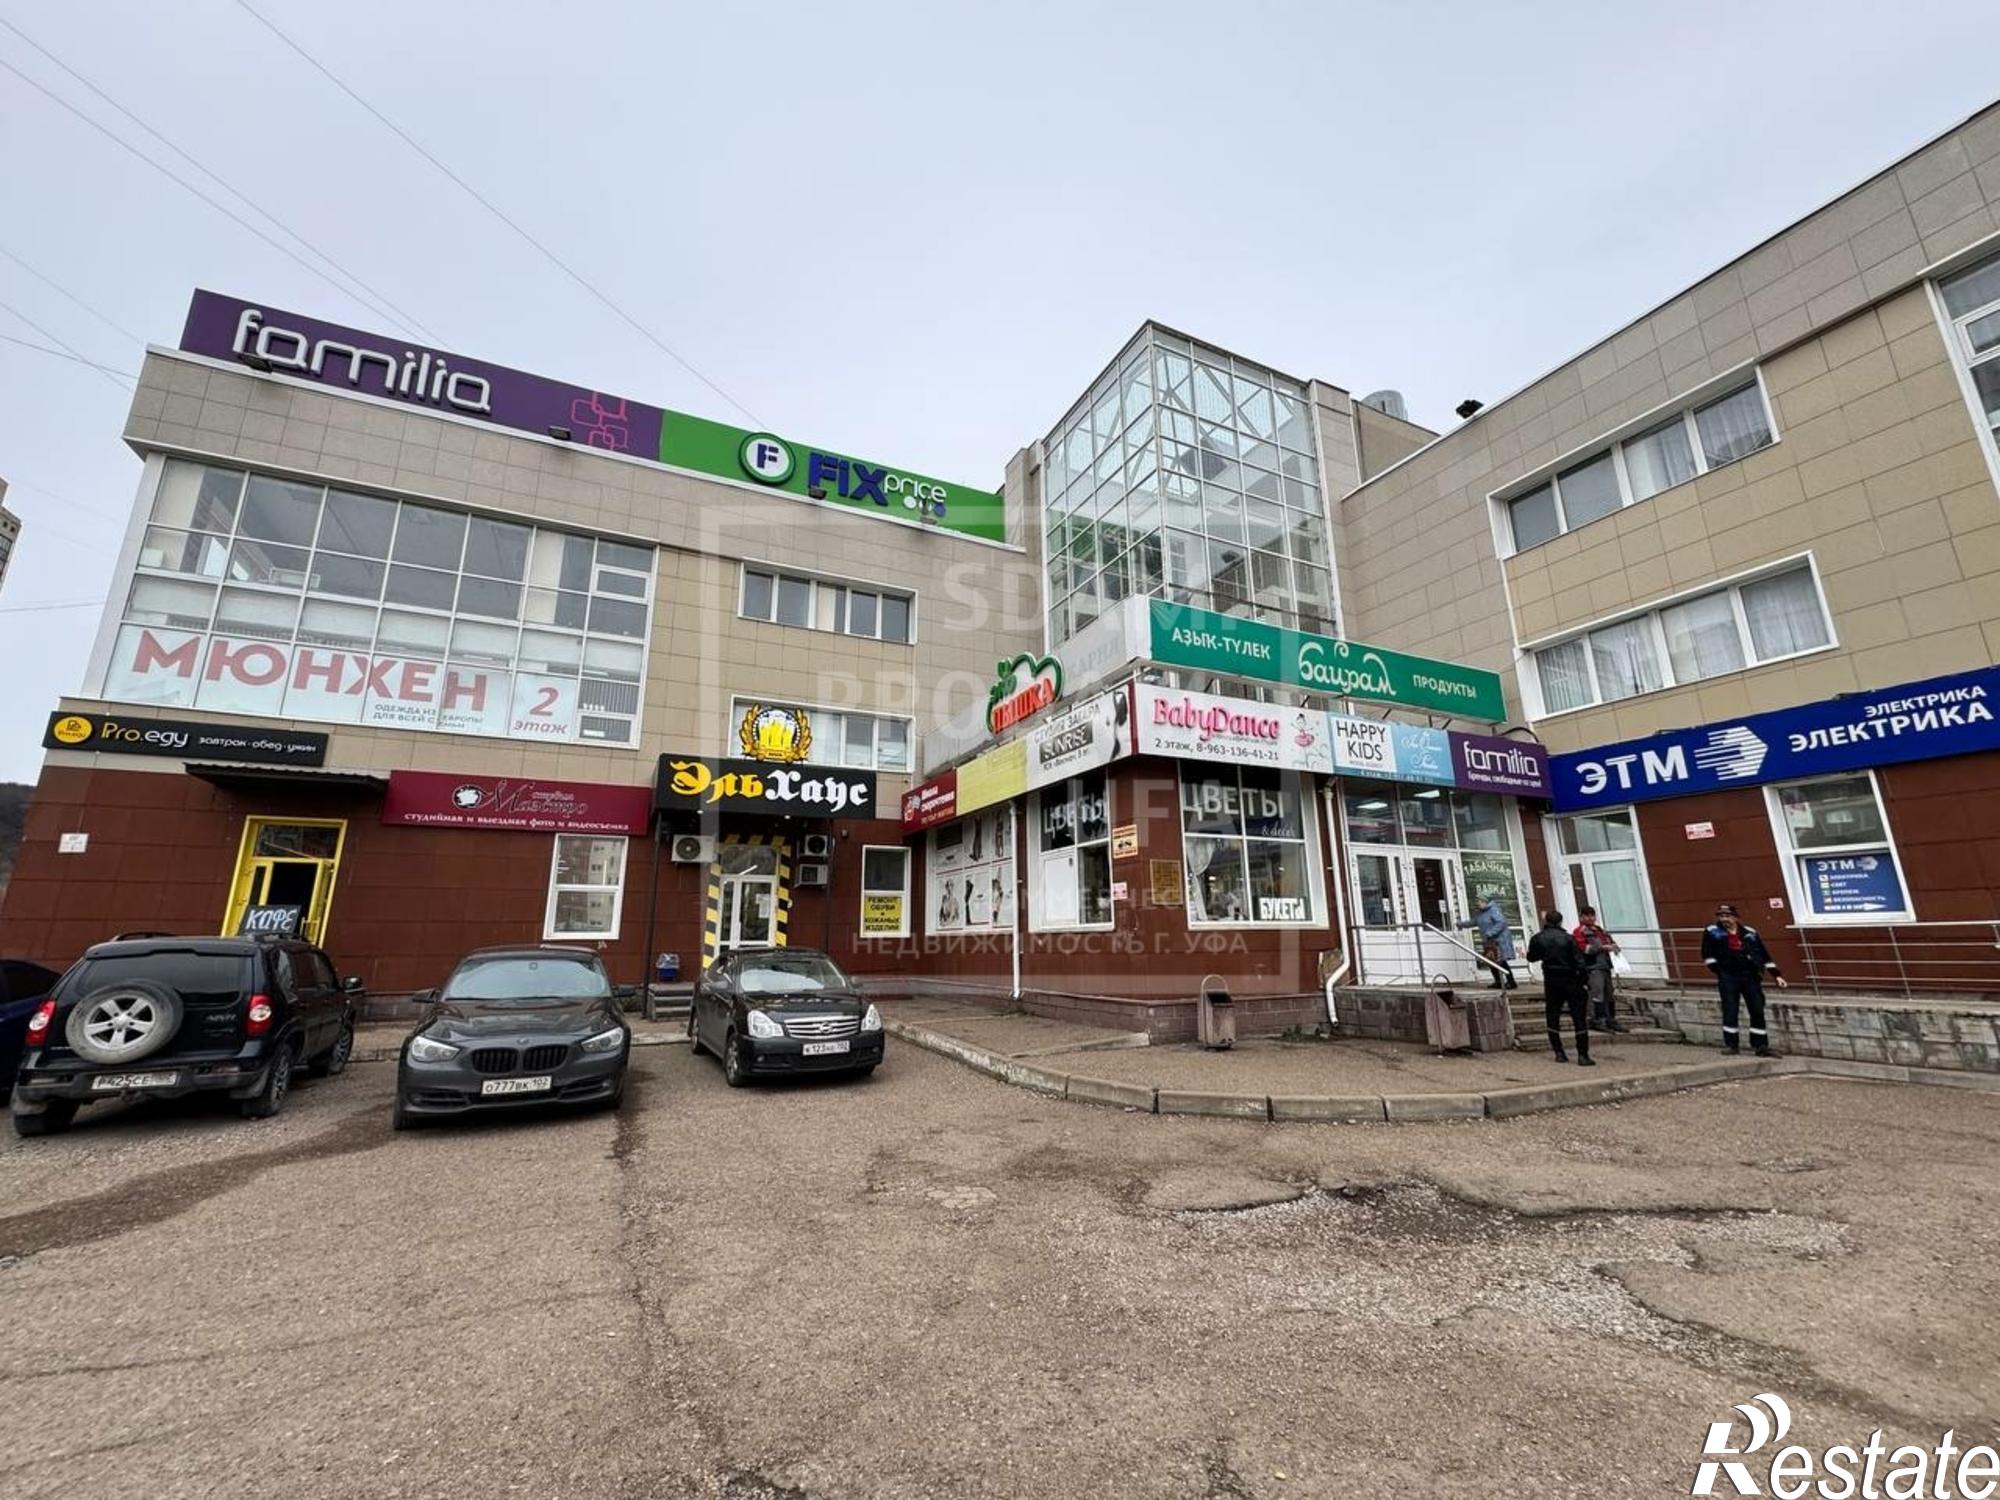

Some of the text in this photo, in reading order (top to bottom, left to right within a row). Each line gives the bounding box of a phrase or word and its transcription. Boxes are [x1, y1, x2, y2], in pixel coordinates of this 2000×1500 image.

[232, 309, 492, 413] familia
[884, 474, 947, 504] price
[132, 630, 487, 711] МЮНХЕН
[529, 687, 559, 716] 2
[1412, 674, 1477, 699] ПРОДУКТЫ
[1864, 685, 1987, 719] ЭЛЕКТРИКА
[513, 719, 568, 735] этаж
[1153, 697, 1281, 742] BabyDance
[1336, 720, 1386, 742] HAPPY
[1155, 738, 1162, 748] 2
[1347, 740, 1384, 761] KIDS
[1575, 700, 1994, 796] ЭТМ ЭЛЕКТРИКА
[1463, 741, 1540, 776] familia
[1182, 784, 1284, 821] ЦВЕТЫ
[1817, 860, 1856, 872] ЭТМ
